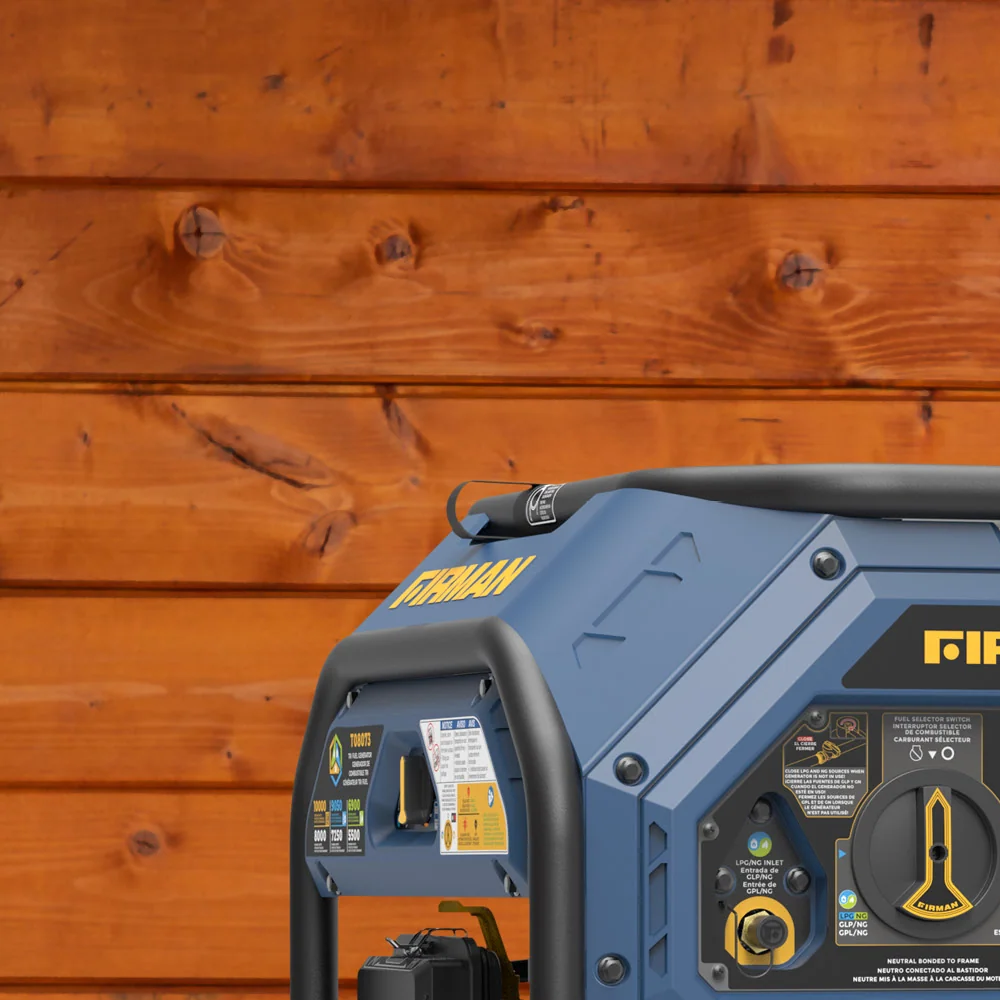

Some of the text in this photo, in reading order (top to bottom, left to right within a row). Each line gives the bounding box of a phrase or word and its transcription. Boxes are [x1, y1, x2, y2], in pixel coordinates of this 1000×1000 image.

[388, 555, 536, 610] FIRMAN
[350, 732, 371, 747] T08073
[314, 829, 360, 842] 8000 7250 5500
[918, 901, 958, 912] FIRMAN
